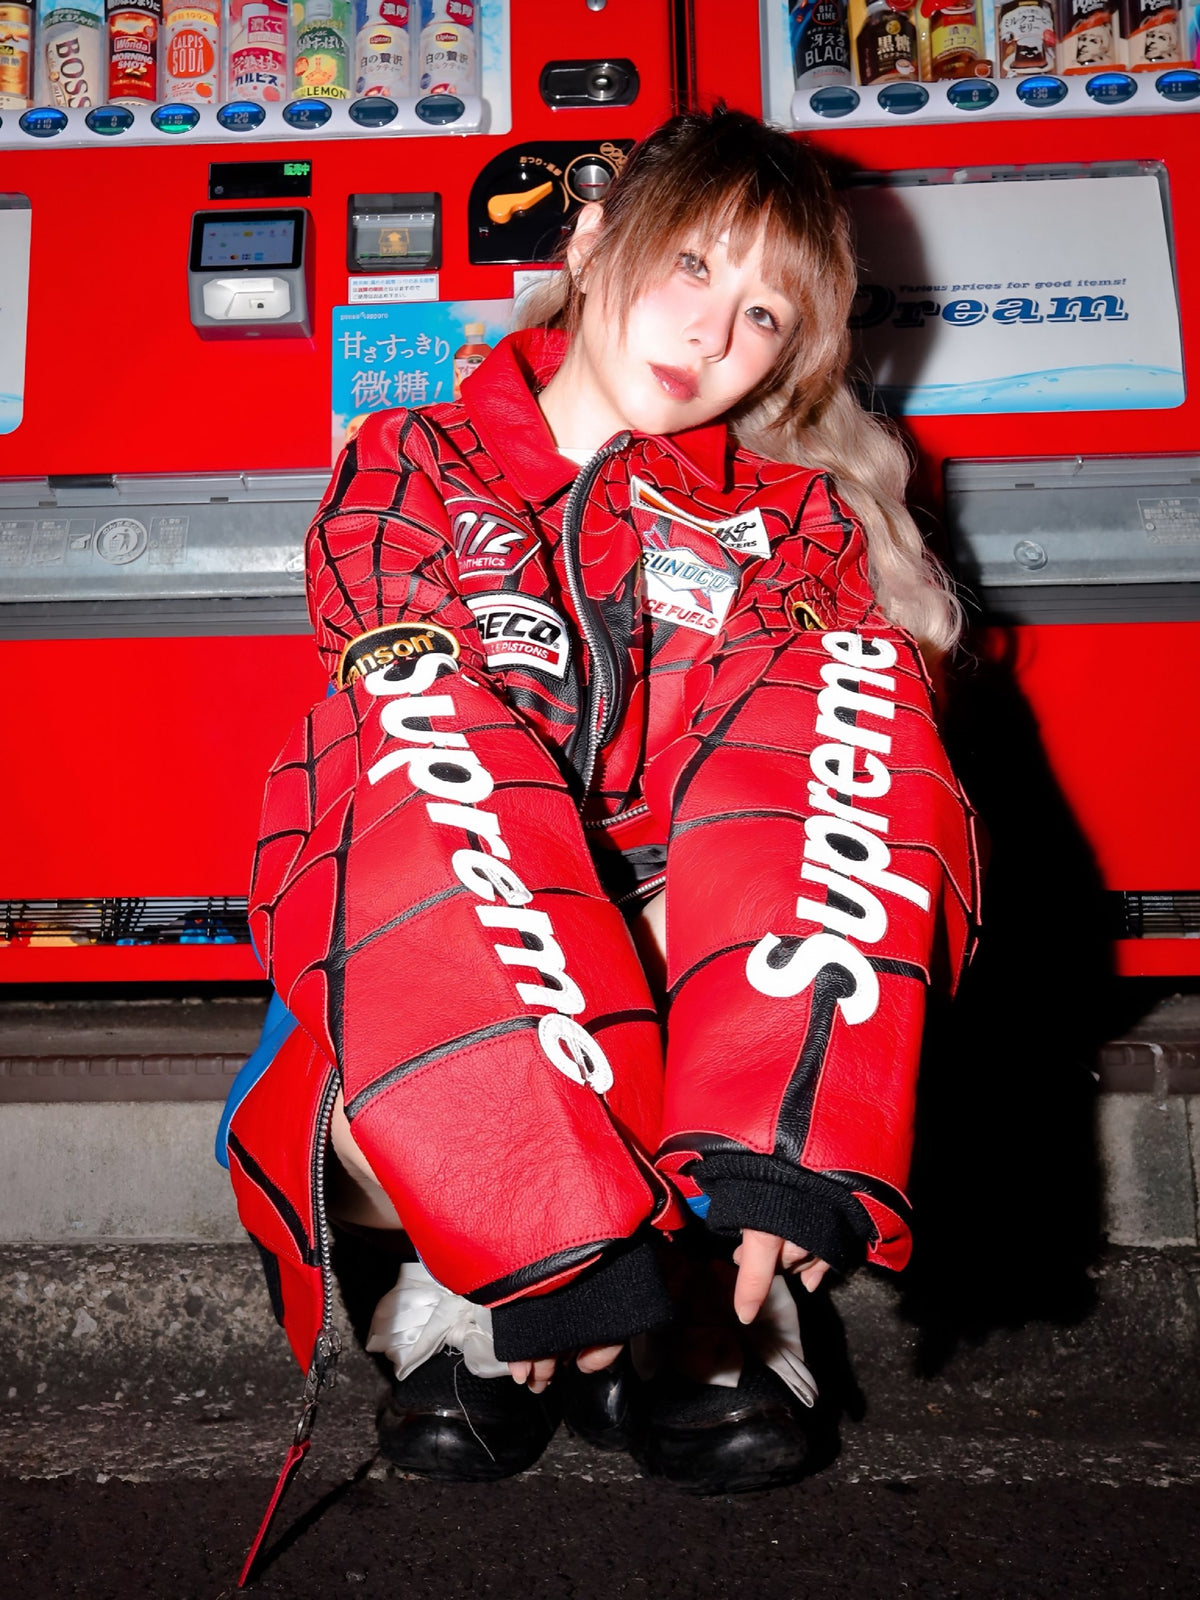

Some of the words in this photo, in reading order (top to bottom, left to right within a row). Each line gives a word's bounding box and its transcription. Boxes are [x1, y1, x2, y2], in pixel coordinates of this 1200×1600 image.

[816, 12, 837, 20] TIME
[819, 4, 833, 12] BIZ
[116, 39, 148, 51] Wonda
[172, 34, 204, 50] CALPIS
[811, 33, 845, 48] 冴える
[112, 53, 153, 64] MORNING
[172, 48, 205, 75] SODA
[805, 46, 849, 67] BLACK
[56, 38, 91, 108] BOSS
[117, 62, 146, 70] SHOT
[236, 72, 278, 87] カルピス
[307, 86, 346, 100] LEMON
[952, 282, 1002, 293] prices
[1006, 280, 1031, 290] for
[1035, 279, 1072, 290] good
[1077, 278, 1128, 288] items!
[847, 284, 1129, 329] Dream
[337, 331, 450, 365] 甘さすっきり
[641, 552, 731, 589] SUNOCO
[665, 605, 719, 630] FUELS
[502, 642, 549, 659] PISTONS
[745, 631, 931, 1025] Supreme
[367, 652, 613, 1095] Supreme
